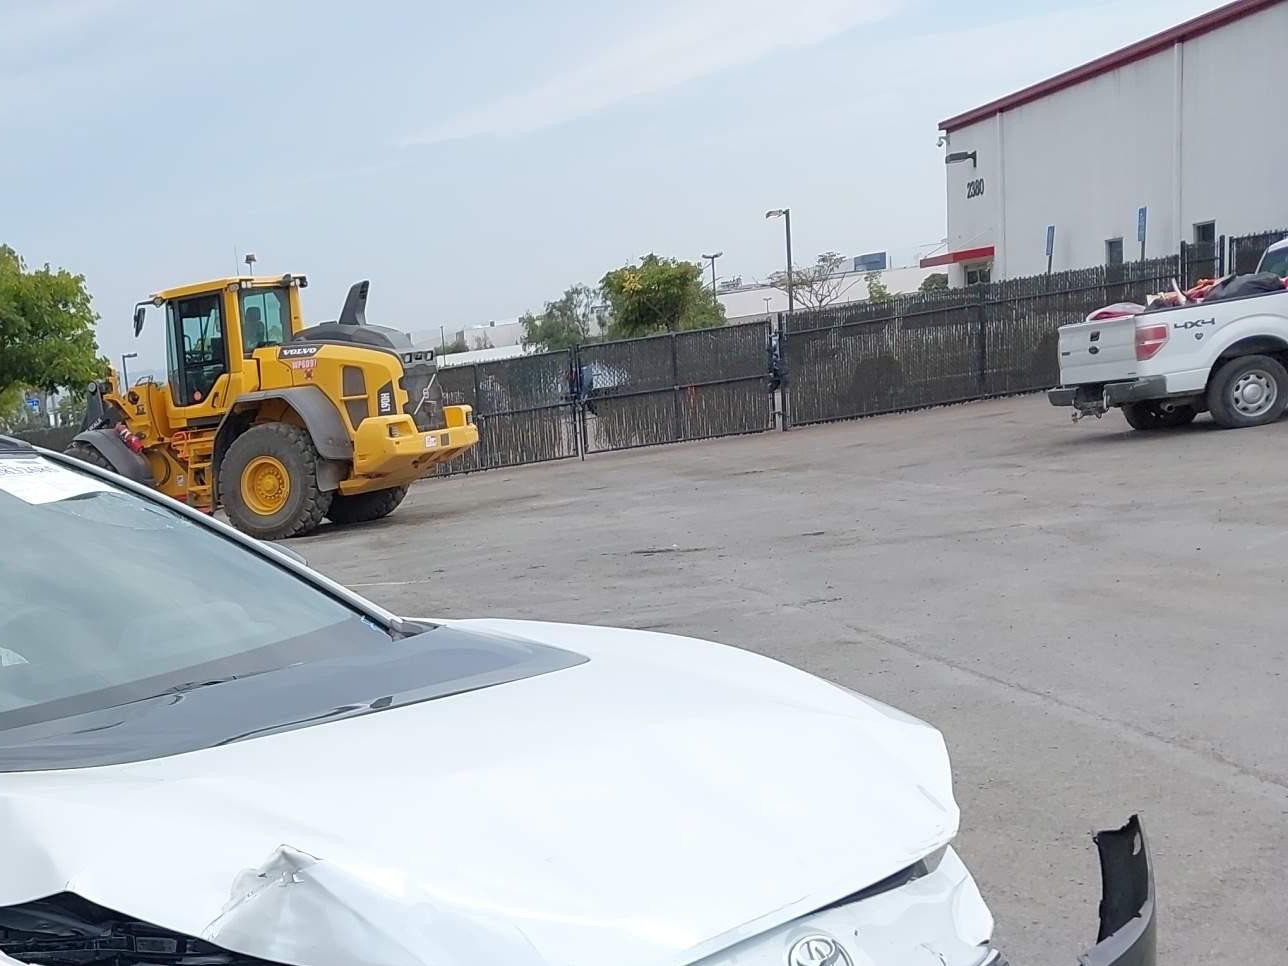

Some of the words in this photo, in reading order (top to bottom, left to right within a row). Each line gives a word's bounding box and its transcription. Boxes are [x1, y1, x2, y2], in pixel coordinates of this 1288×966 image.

[967, 178, 984, 199] 2380
[283, 347, 317, 356] VOLVO
[380, 392, 391, 412] L90H
